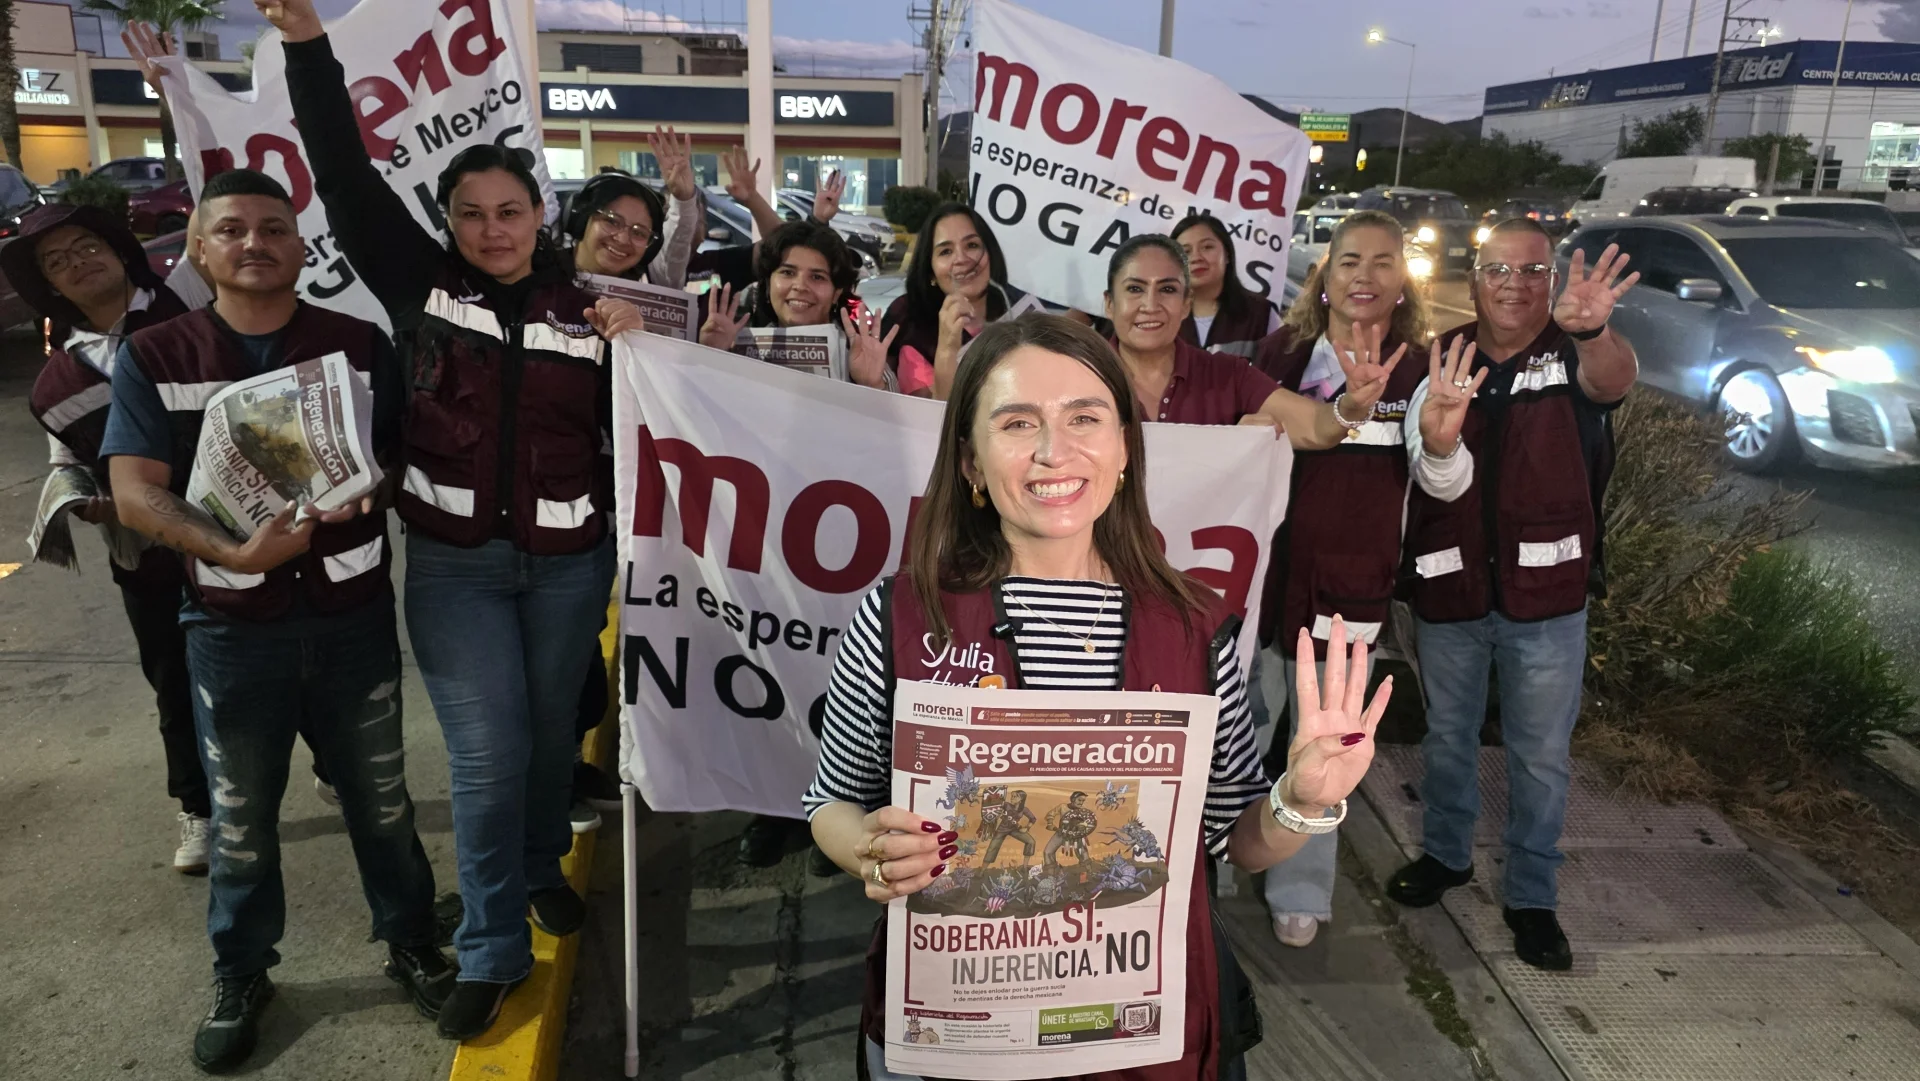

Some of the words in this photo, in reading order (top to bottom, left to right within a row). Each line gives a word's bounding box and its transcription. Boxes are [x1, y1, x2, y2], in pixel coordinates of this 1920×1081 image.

[1855, 71, 1901, 81] ATENCIÓN
[1902, 72, 1909, 81] A
[548, 88, 616, 111] BBVA
[780, 95, 847, 118] BBVA
[415, 80, 521, 155] Mexco
[974, 51, 1286, 217] morena
[988, 141, 1130, 206] esperanza
[1140, 194, 1174, 220] de
[304, 381, 343, 481] Regeneración
[625, 561, 678, 607] La
[913, 702, 963, 717] morena
[949, 733, 1175, 773] Regeneración
[913, 912, 1058, 952] SOBERANÍA,
[952, 949, 1098, 985] INJERENCIA,
[1105, 930, 1150, 974] NO
[967, 994, 993, 1002] mentiras
[1010, 992, 1033, 1000] derecha
[1035, 991, 1062, 999] mexicana
[971, 988, 987, 996] dejes
[1012, 987, 1022, 995] por
[1030, 985, 1049, 993] guerra
[1042, 1013, 1067, 1025] ÚNETE
[1042, 1033, 1071, 1042] morena
